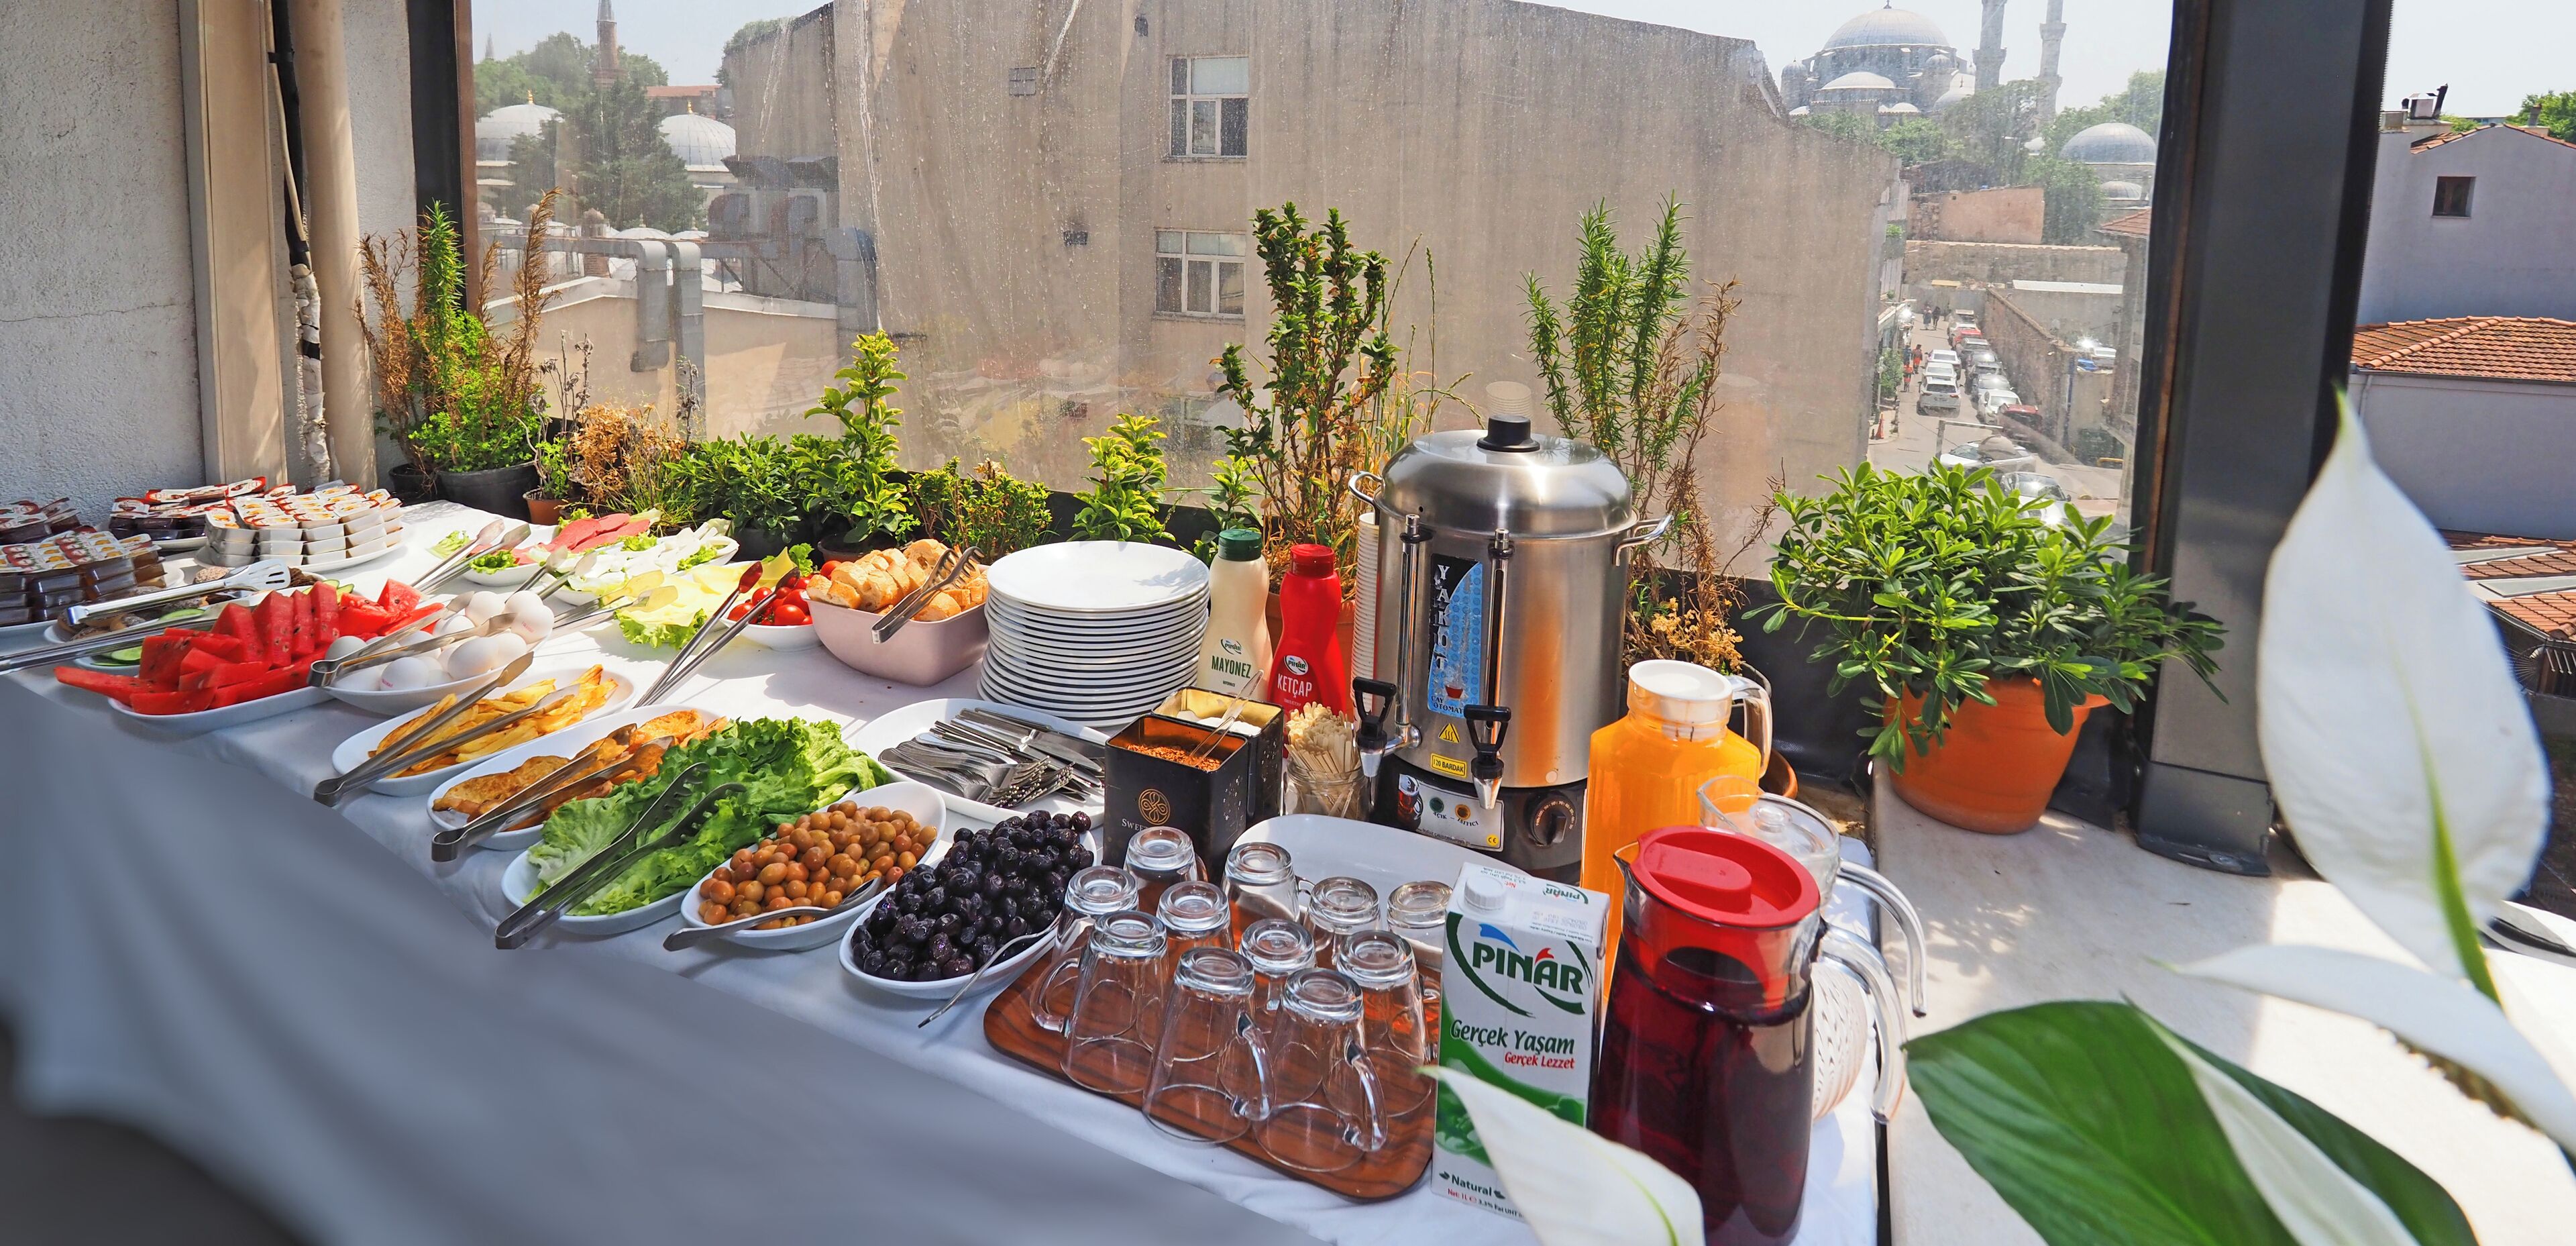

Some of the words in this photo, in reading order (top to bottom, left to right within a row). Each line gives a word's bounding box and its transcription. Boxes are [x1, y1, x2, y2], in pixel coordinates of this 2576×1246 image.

[1224, 643, 1242, 652] PINAR
[1212, 656, 1252, 678] MAYONEZ
[1287, 660, 1306, 670] PINAR
[1277, 673, 1313, 698] KETÇAP
[1442, 761, 1464, 773] BARDAK
[1122, 818, 1148, 831] SWEE
[1545, 886, 1580, 900] PINAR
[1472, 941, 1584, 995] PINAR
[1450, 1019, 1509, 1048] Gerçek
[1514, 1029, 1575, 1055] Yaşam
[1505, 1051, 1539, 1067] Gerçek
[1541, 1055, 1575, 1070] Lezzet
[1451, 1174, 1493, 1196] Natural
[1505, 1208, 1518, 1217] UHT
